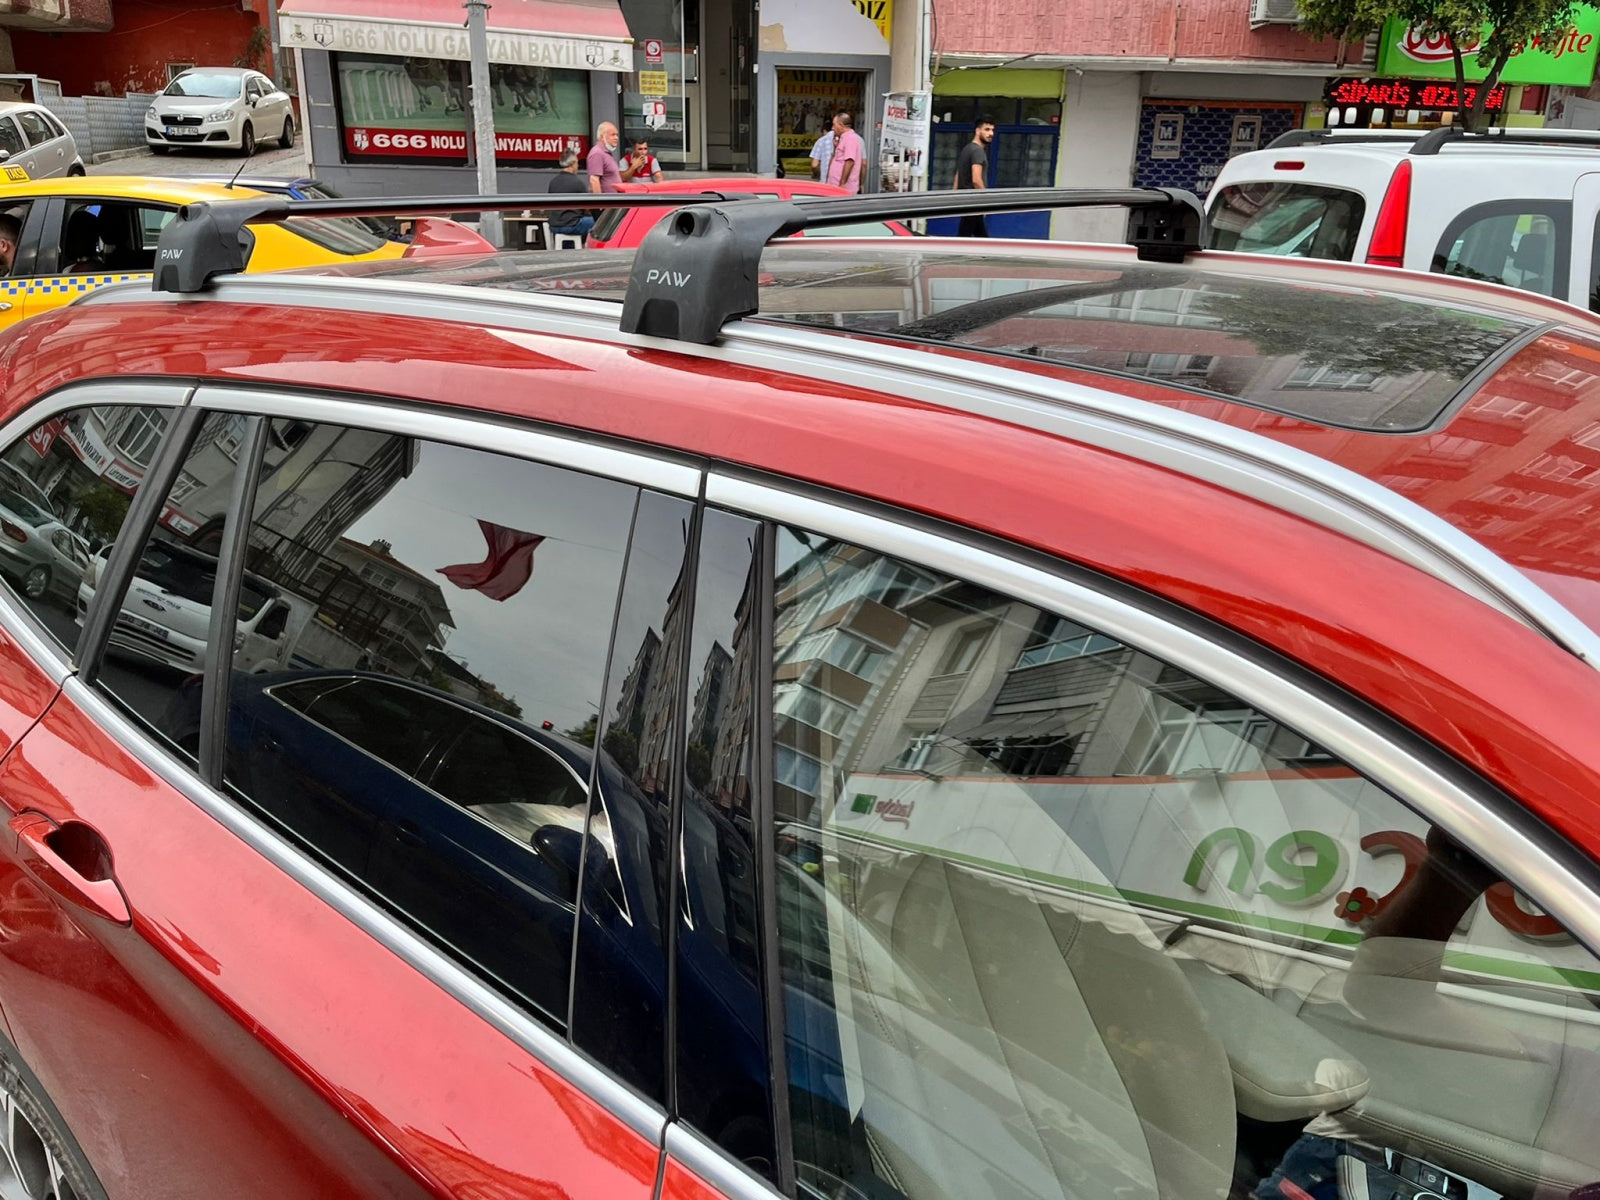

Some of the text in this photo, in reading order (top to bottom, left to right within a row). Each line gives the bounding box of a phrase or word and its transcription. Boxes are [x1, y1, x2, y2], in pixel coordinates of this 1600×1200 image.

[342, 28, 377, 49] 666
[384, 30, 436, 55] NOLU
[443, 36, 522, 62] GAYAN
[373, 134, 563, 152] 666 NOLU ANYAN BAYİ
[161, 249, 183, 259] PAW
[646, 269, 691, 288] PAW
